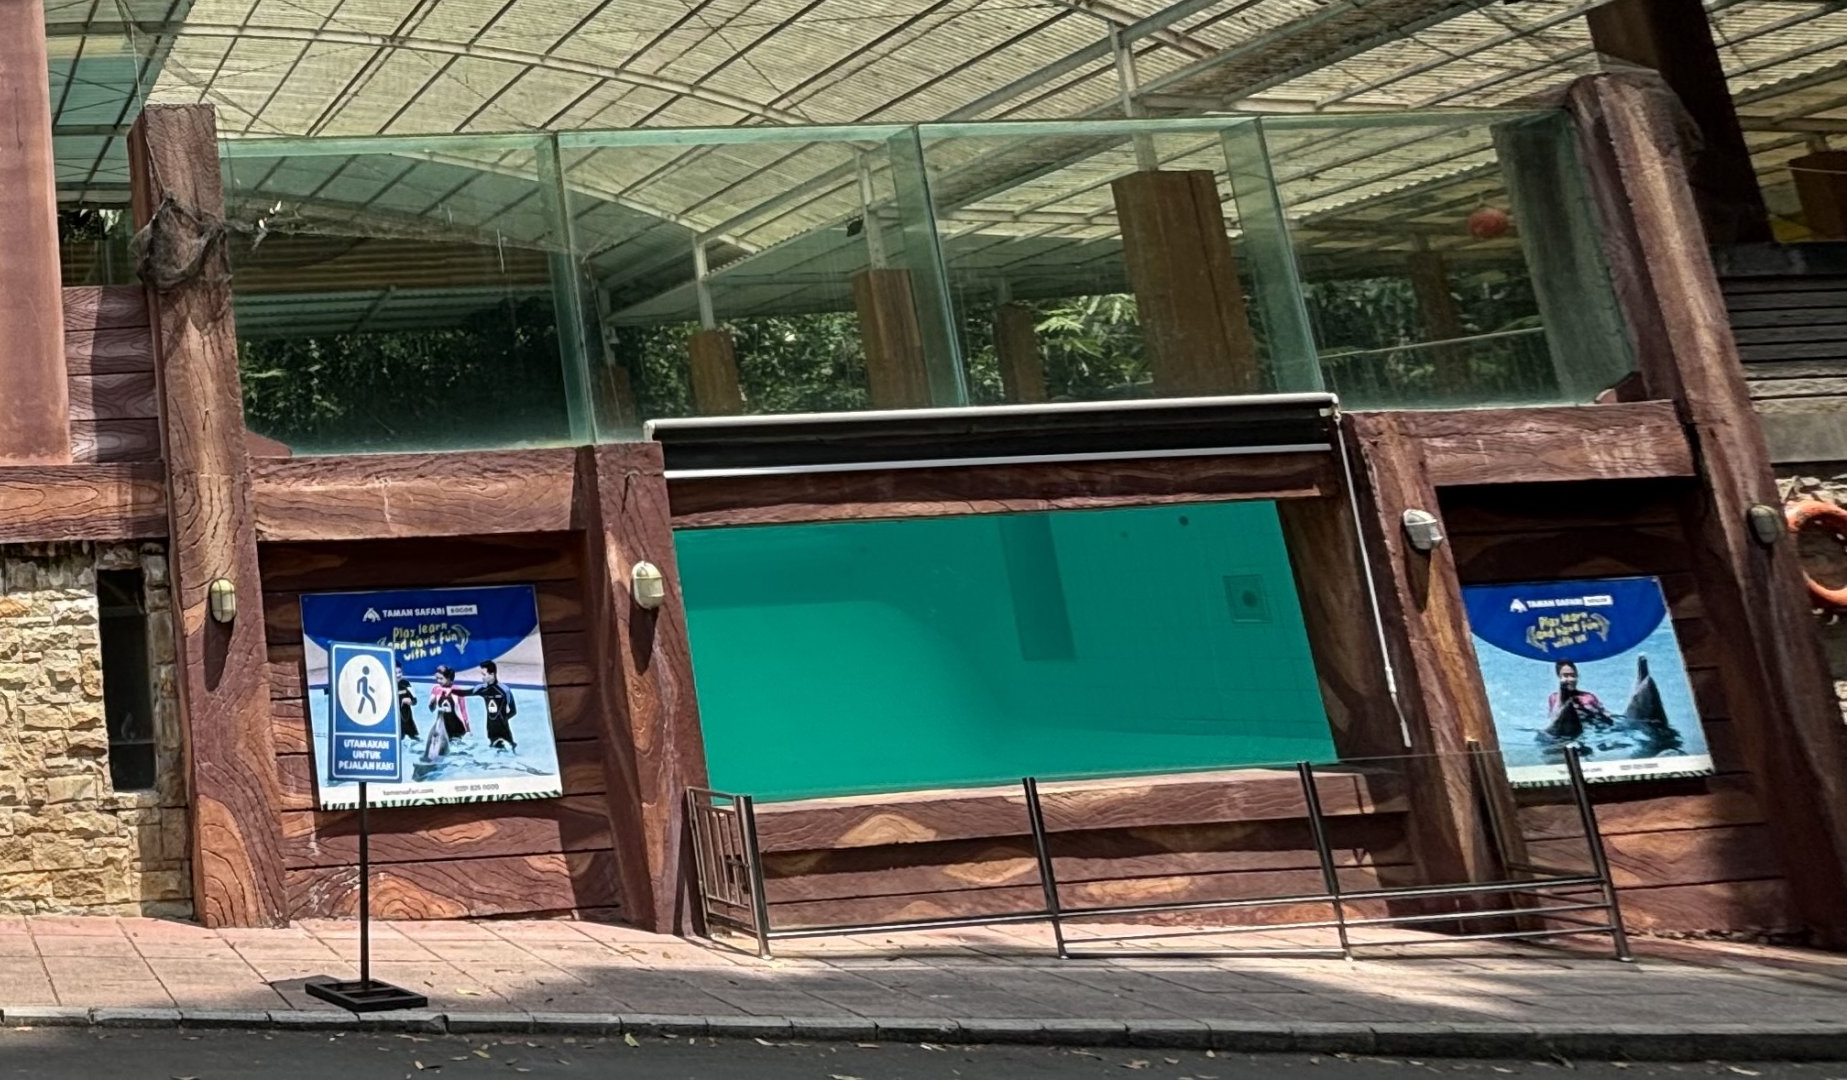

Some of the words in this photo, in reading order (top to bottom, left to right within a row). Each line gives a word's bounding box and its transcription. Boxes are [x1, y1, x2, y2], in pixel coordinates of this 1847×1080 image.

[382, 609, 413, 618] TAMAN
[414, 607, 446, 617] SAFARI
[419, 622, 448, 635] learn
[409, 634, 437, 649] have
[439, 631, 458, 645] fun
[403, 648, 427, 661] with
[343, 739, 390, 750] UTAMAKAN
[352, 750, 381, 760] UNTUK
[338, 760, 375, 770] PEJALAN
[375, 761, 395, 771] KAKI
